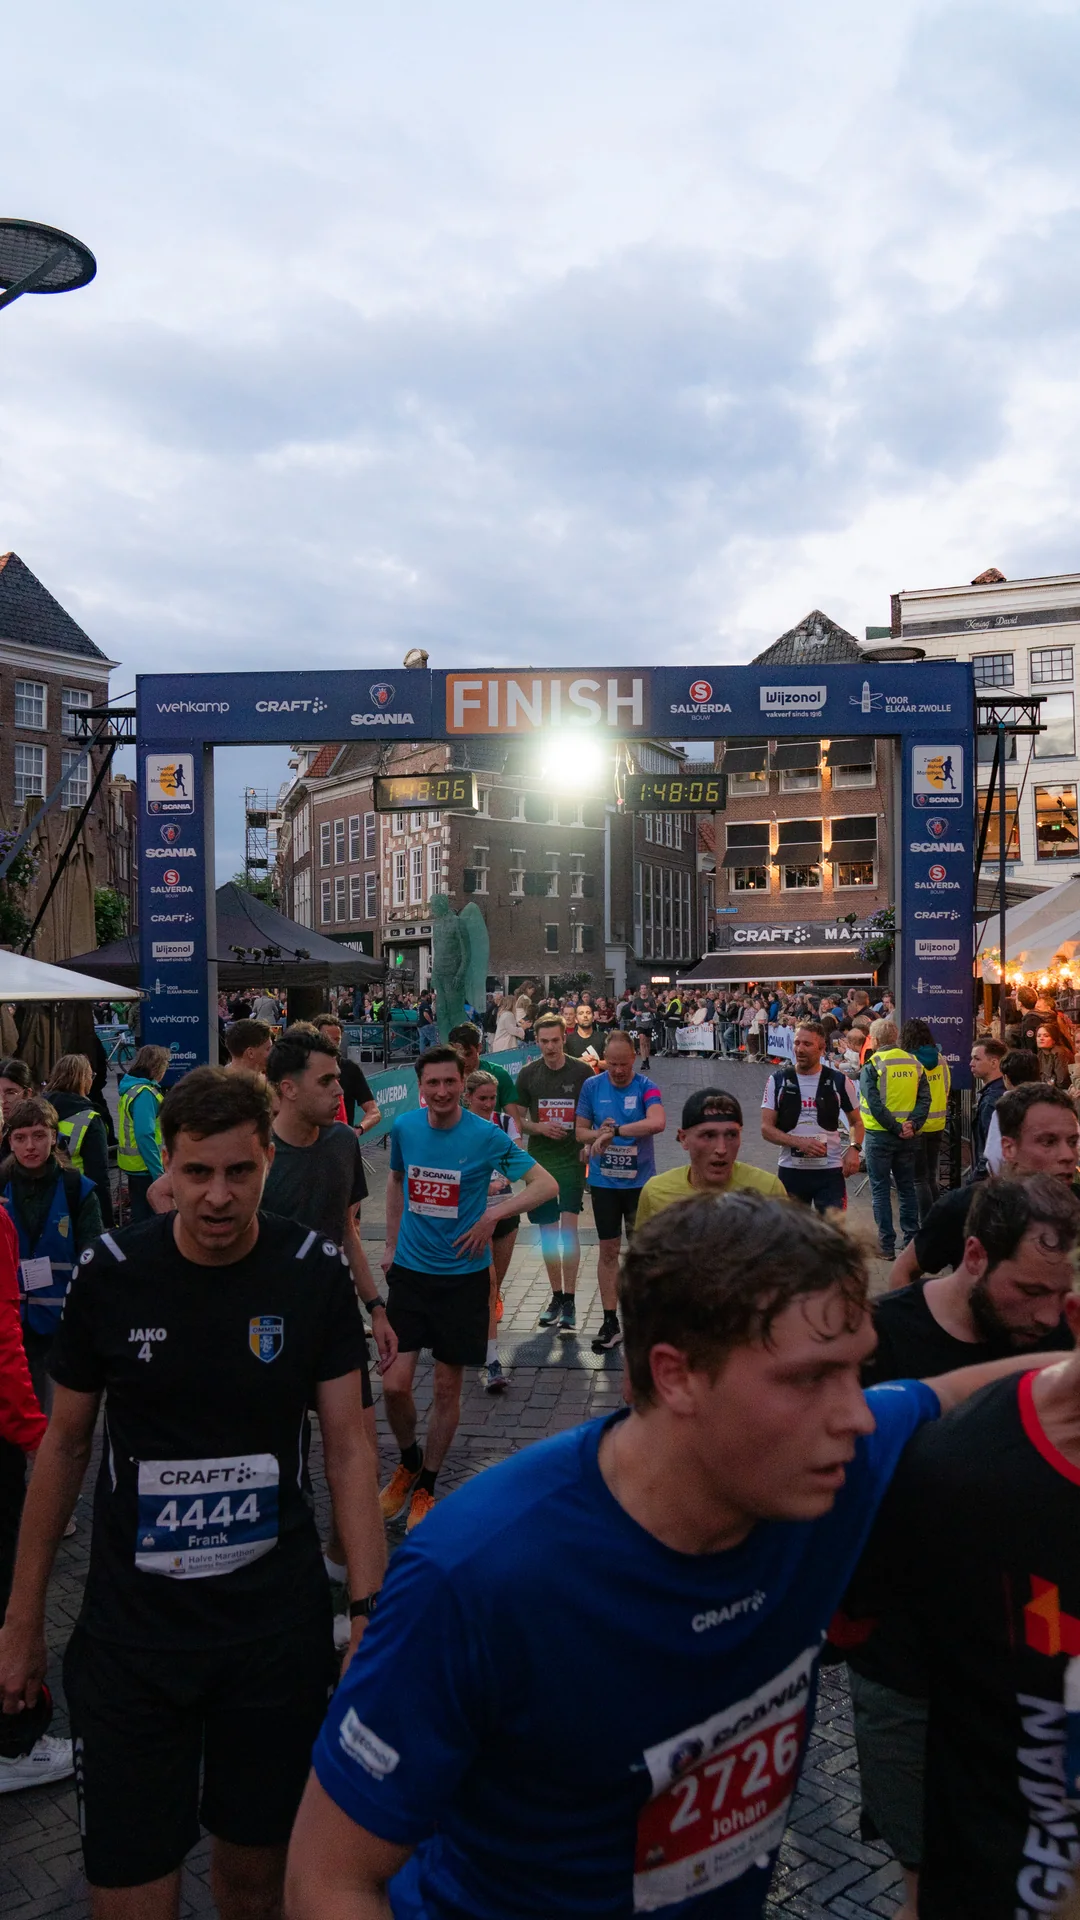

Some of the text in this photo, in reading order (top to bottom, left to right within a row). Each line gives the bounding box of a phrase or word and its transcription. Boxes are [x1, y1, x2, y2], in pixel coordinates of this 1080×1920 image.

[995, 616, 1019, 626] David
[453, 678, 643, 728] FINISH
[766, 690, 821, 706] Wijzonol
[885, 696, 908, 704] VOOR
[156, 700, 229, 713] wehkamp
[255, 700, 311, 712] CRAFT
[670, 703, 732, 714] SALVERDA
[885, 704, 951, 713] ELKAAR ZWOLLE
[350, 713, 415, 726] SCANIA
[388, 779, 466, 802] 1:48:06
[640, 782, 719, 803] 1:48:06
[145, 848, 197, 858] SCANIA
[910, 842, 966, 853] SCANIA
[150, 914, 184, 923] CRAFT
[914, 911, 951, 919] CRAFT
[733, 929, 793, 942] CRAFT
[155, 944, 191, 955] Wijzonol
[919, 943, 956, 953] Wijzonol
[150, 1015, 200, 1024] wehkamp
[768, 1036, 785, 1049] CANIA
[168, 1051, 197, 1061] gmedia
[891, 1071, 914, 1079] JURY
[926, 1073, 942, 1082] URY
[376, 1083, 408, 1103] SALVERDA
[546, 1108, 565, 1118] 411
[605, 1154, 632, 1166] 3392
[413, 1181, 451, 1198] 3225
[128, 1328, 167, 1342] JAKO
[252, 1326, 281, 1334] OMMEN
[137, 1342, 153, 1362] 4
[160, 1467, 235, 1485] CRAFT
[156, 1493, 260, 1532] 4444
[188, 1531, 228, 1548] Frank
[188, 1548, 255, 1564] Halve Marathon
[691, 1598, 752, 1633] CRAFT
[670, 1722, 799, 1833] 2726
[1016, 1692, 1080, 1920] GEMAN
[710, 1799, 768, 1842] Johan
